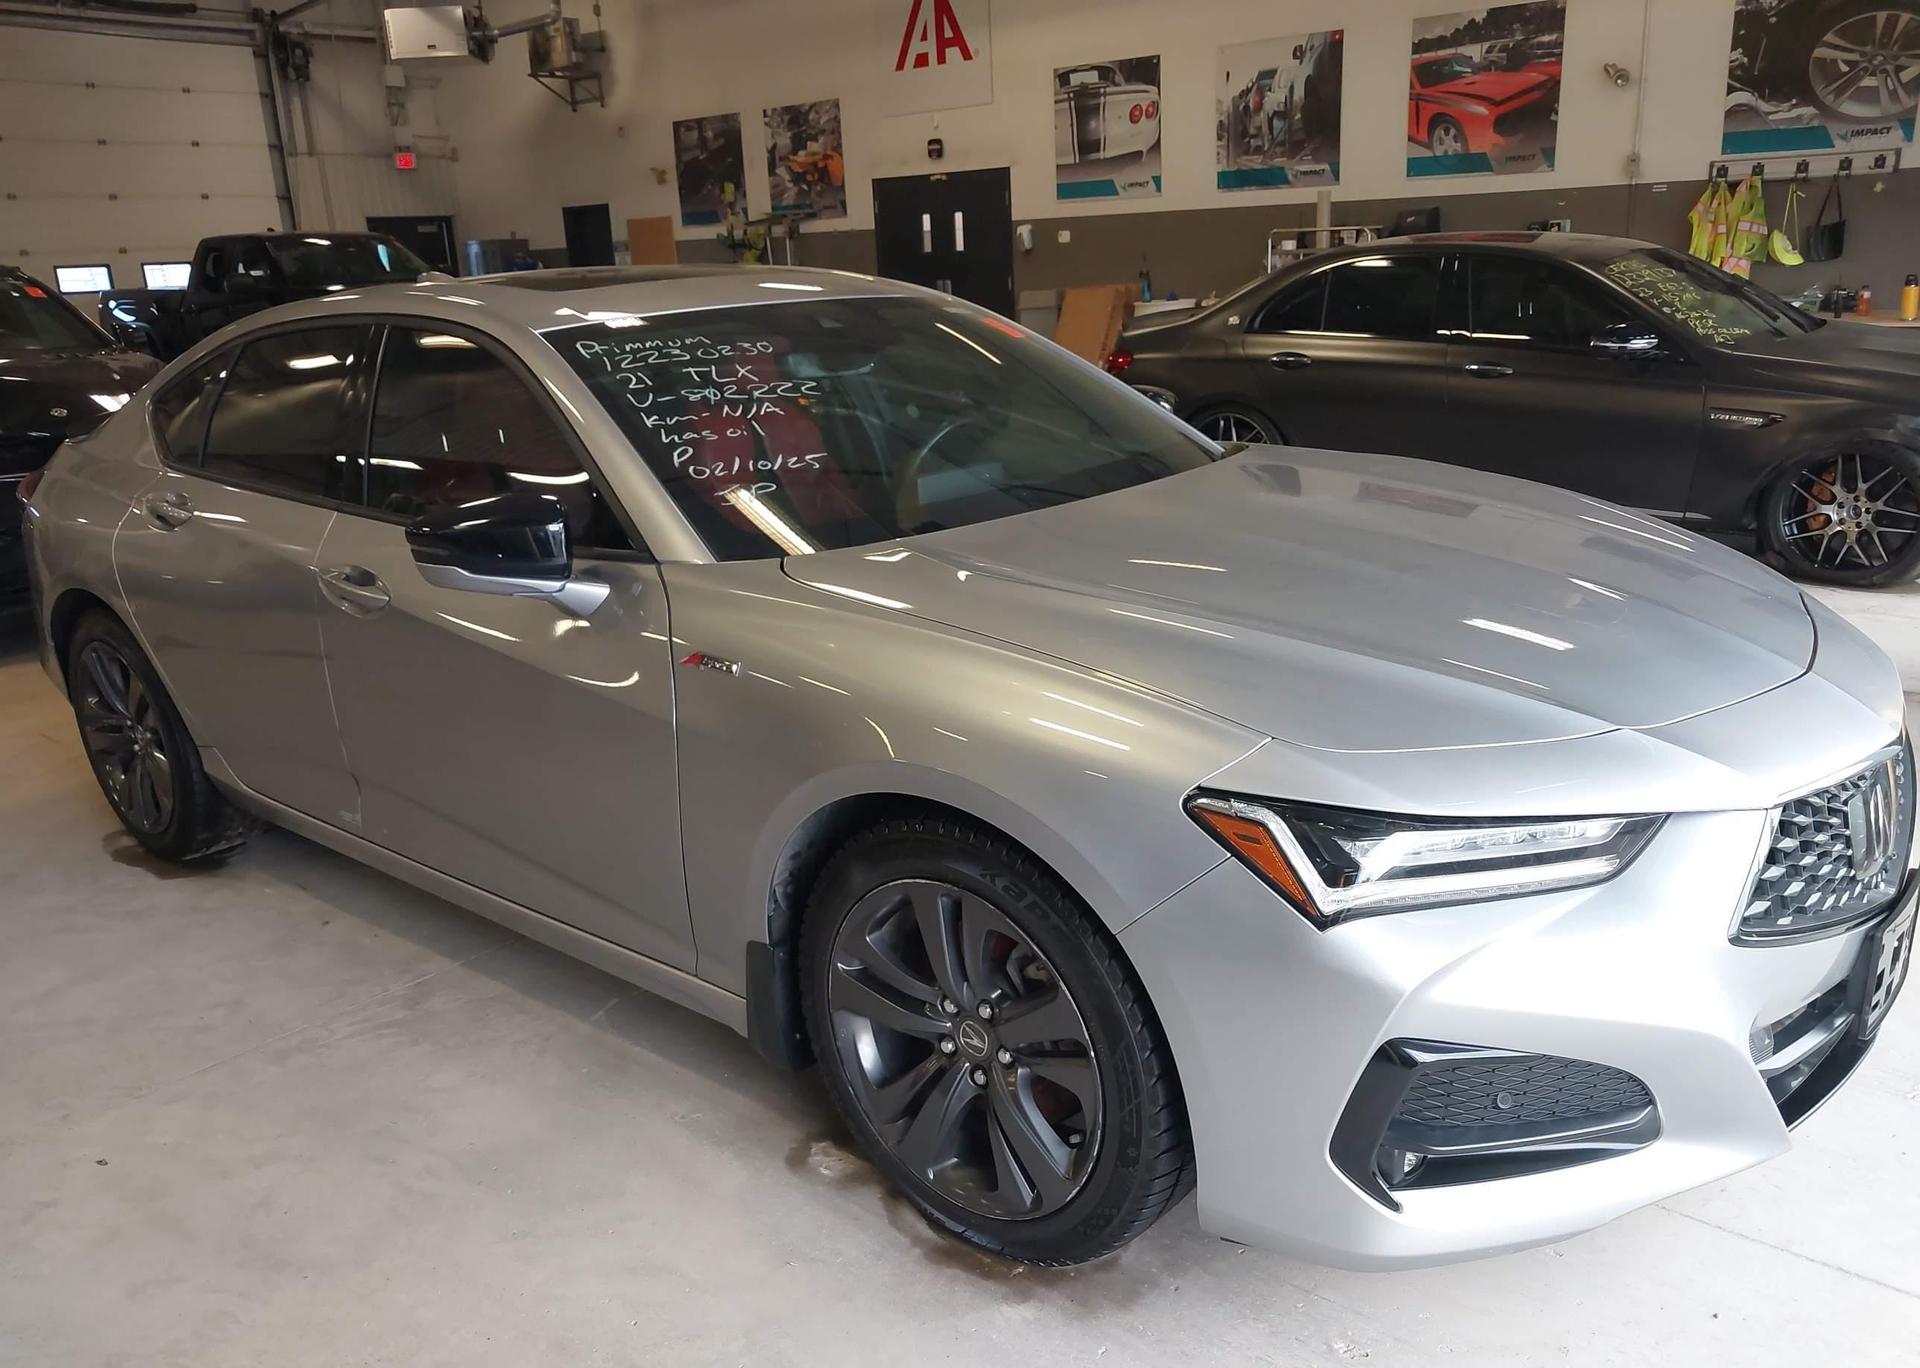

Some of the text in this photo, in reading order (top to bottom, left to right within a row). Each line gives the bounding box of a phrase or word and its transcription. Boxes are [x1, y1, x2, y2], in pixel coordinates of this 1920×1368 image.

[1850, 126, 1893, 138] IMPACT
[616, 364, 760, 389] 21 TLX
[722, 402, 785, 420] N/A
[660, 420, 766, 444] has oil
[688, 452, 829, 479] 02/10/25
